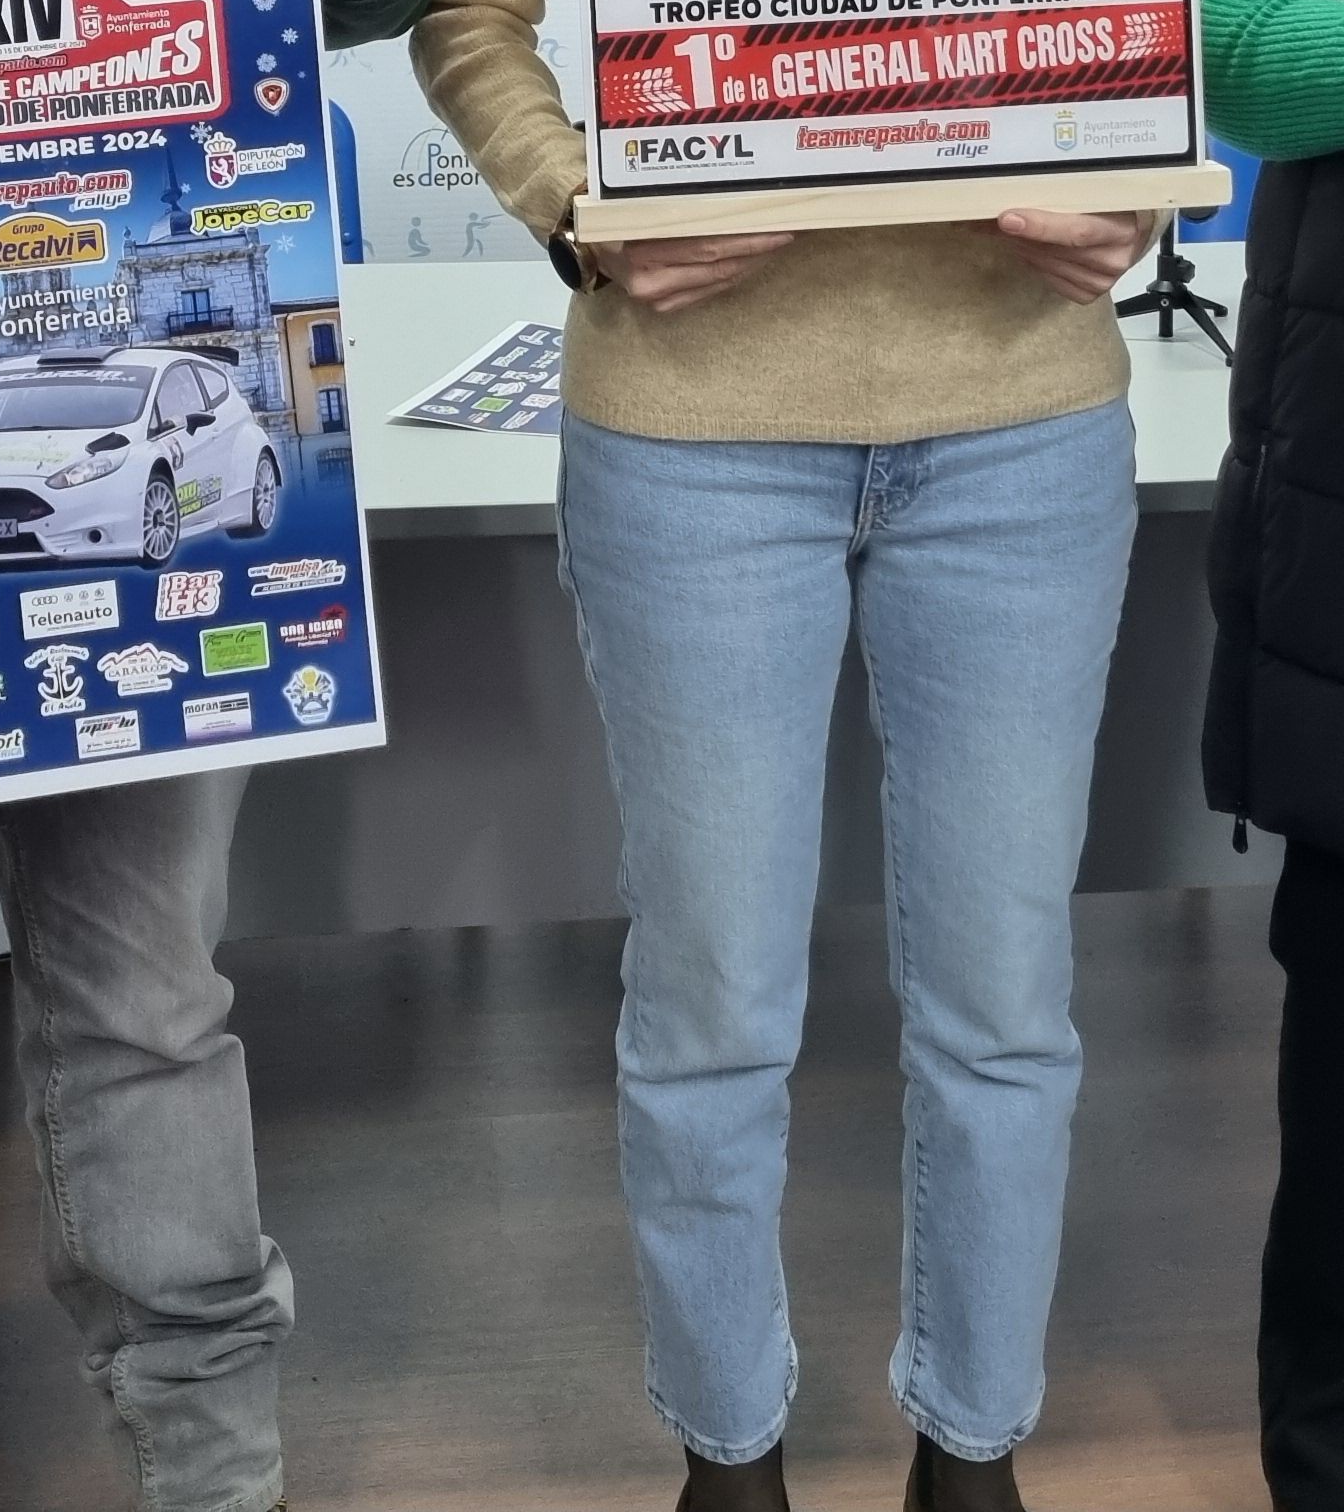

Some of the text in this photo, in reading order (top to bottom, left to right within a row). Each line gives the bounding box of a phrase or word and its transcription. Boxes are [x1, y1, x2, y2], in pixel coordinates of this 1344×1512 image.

[107, 9, 169, 22] Ayuntamiento
[107, 20, 170, 35] Ponferrada
[16, 20, 204, 98] CAMPEONES
[723, 17, 1115, 104] de la GENERAL KART CROSS
[673, 33, 736, 109] 1º
[12, 99, 44, 124] DE
[49, 83, 211, 120] PONFERRADA
[1083, 119, 1156, 133] Ayuntamiento
[102, 129, 167, 152] 2024
[796, 119, 990, 152] teamrepauto.com
[1083, 131, 1157, 148] Ponferrada
[239, 146, 303, 161] DIPUTACIÓN
[640, 135, 753, 163] FACYL
[936, 144, 988, 158] rallye
[240, 159, 284, 172] DE LEÓN
[393, 172, 415, 186] es
[77, 193, 127, 208] rallye
[195, 202, 312, 231] JopeCar
[12, 224, 44, 235] Grupo
[170, 574, 220, 589] Bar
[166, 591, 216, 616] H3
[28, 606, 113, 627] Telenauto
